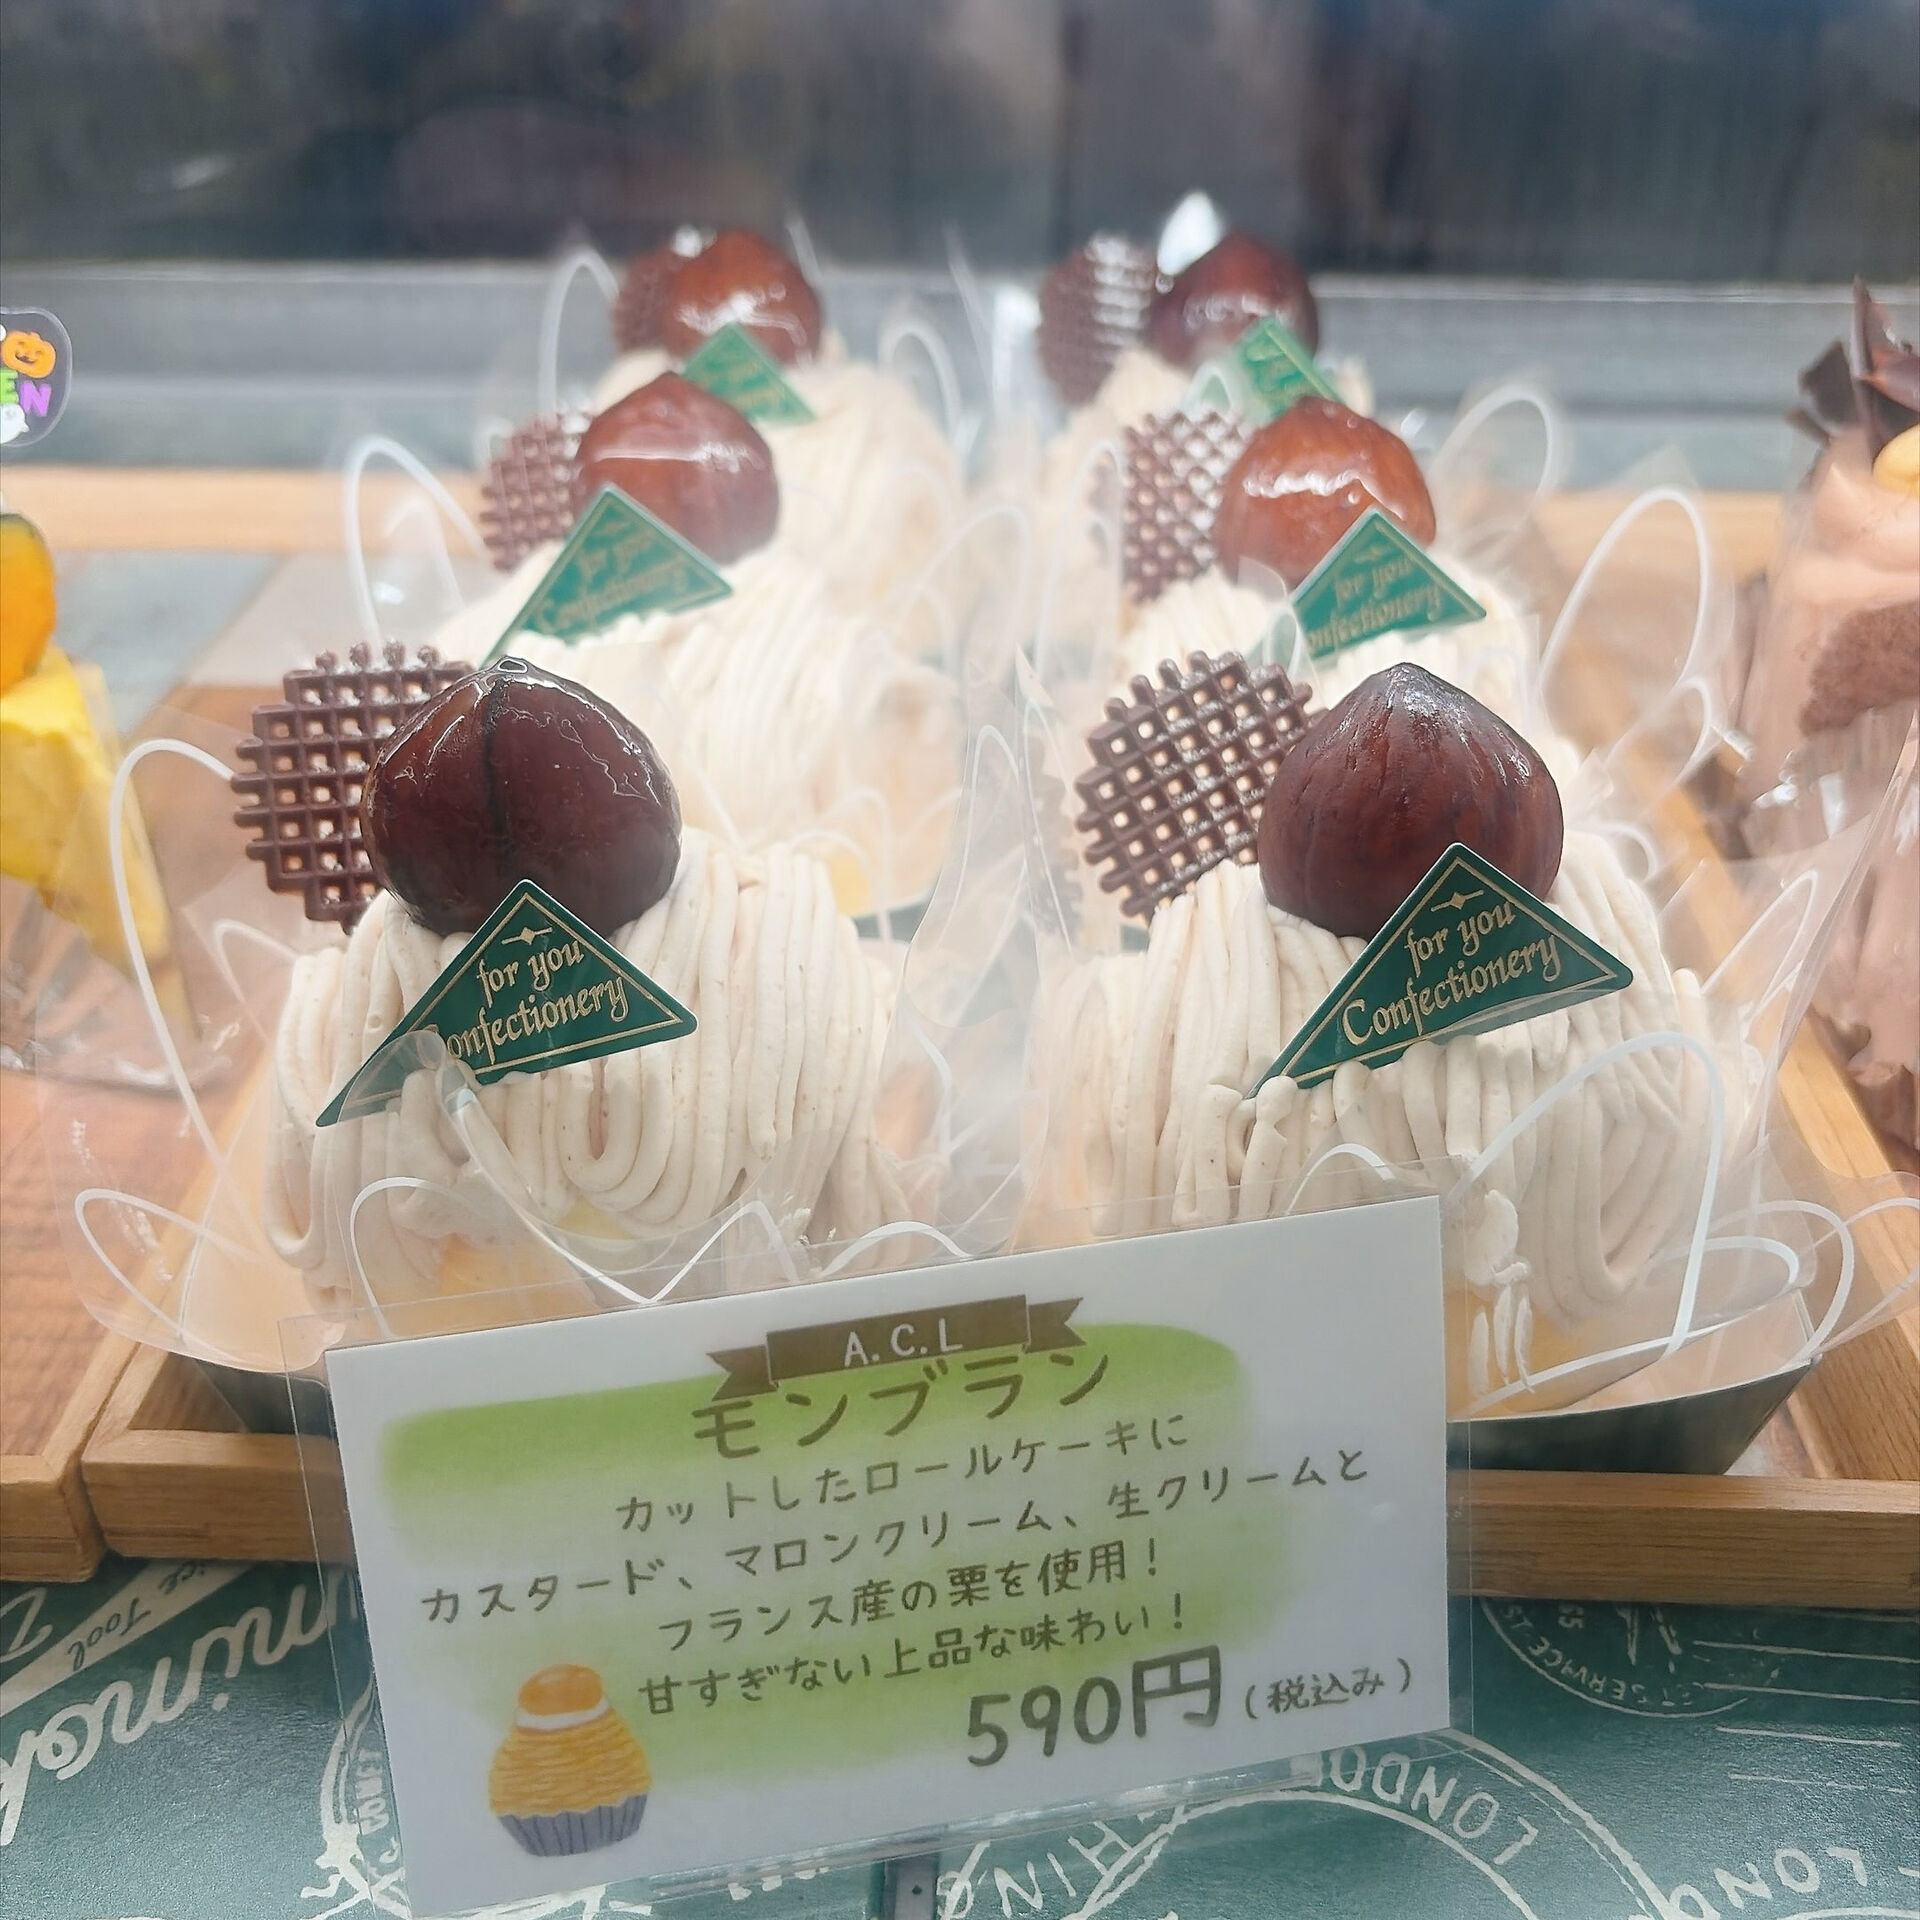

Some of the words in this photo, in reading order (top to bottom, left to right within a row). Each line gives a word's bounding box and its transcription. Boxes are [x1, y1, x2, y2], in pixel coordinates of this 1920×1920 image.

[475, 958, 521, 1009] for
[527, 939, 586, 993] you
[1340, 934, 1562, 1047] Confectionery
[1403, 927, 1449, 979] for
[1457, 901, 1517, 957] you
[442, 975, 629, 1066] onfectionery
[843, 1317, 964, 1368] A.C.L
[691, 1352, 1109, 1459] モンブラン
[615, 1413, 1189, 1532] カットしたロールケーキに
[421, 1449, 1369, 1624] カスタード、マロンクリーム、生クリームと
[67, 1597, 151, 1667] Tool
[657, 1537, 1158, 1652] フランス産の栗を使用！
[638, 1593, 1184, 1715] 甘すぎない上品な味わい！
[966, 1644, 1222, 1768] 590円
[1244, 1657, 1412, 1721] (税込み)
